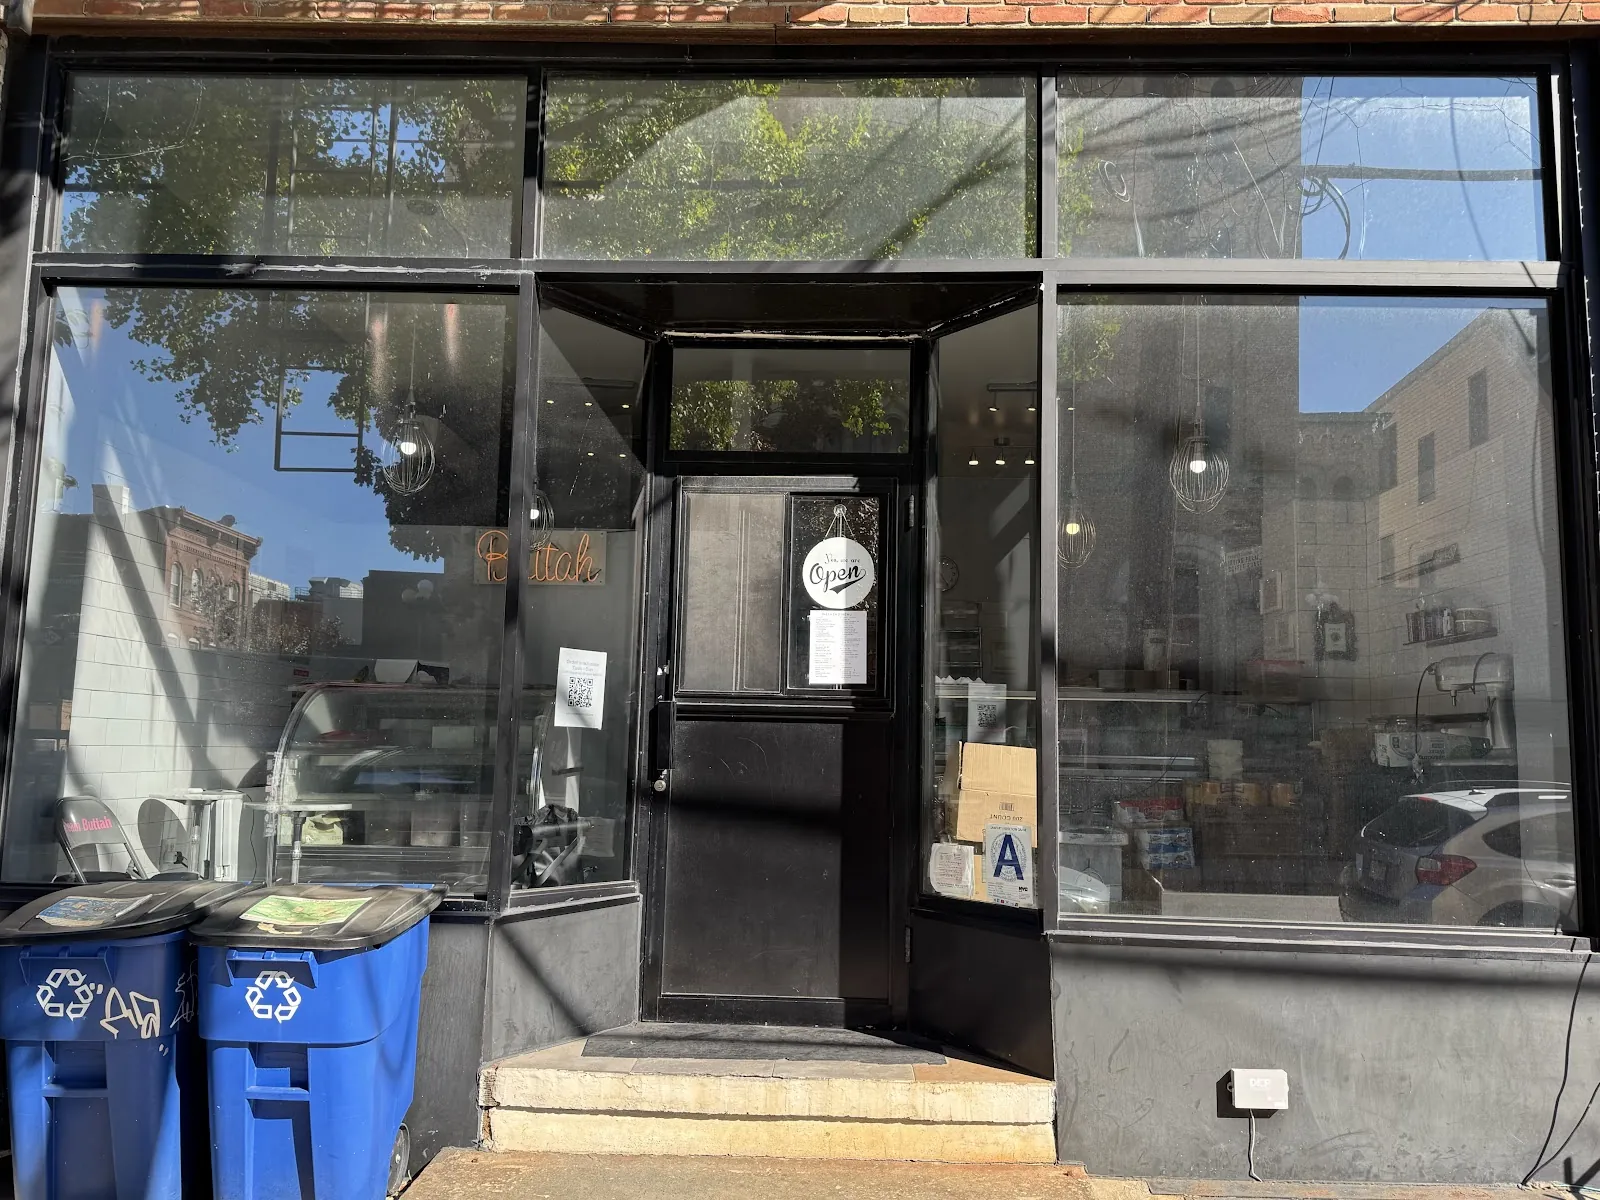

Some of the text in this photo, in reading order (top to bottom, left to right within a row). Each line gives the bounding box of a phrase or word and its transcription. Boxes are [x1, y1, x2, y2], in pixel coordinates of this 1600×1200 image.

[477, 529, 600, 583] Bttah
[809, 562, 867, 593] Open
[81, 815, 113, 831] Buttah
[990, 813, 1011, 821] COUNT
[993, 834, 1025, 880] A
